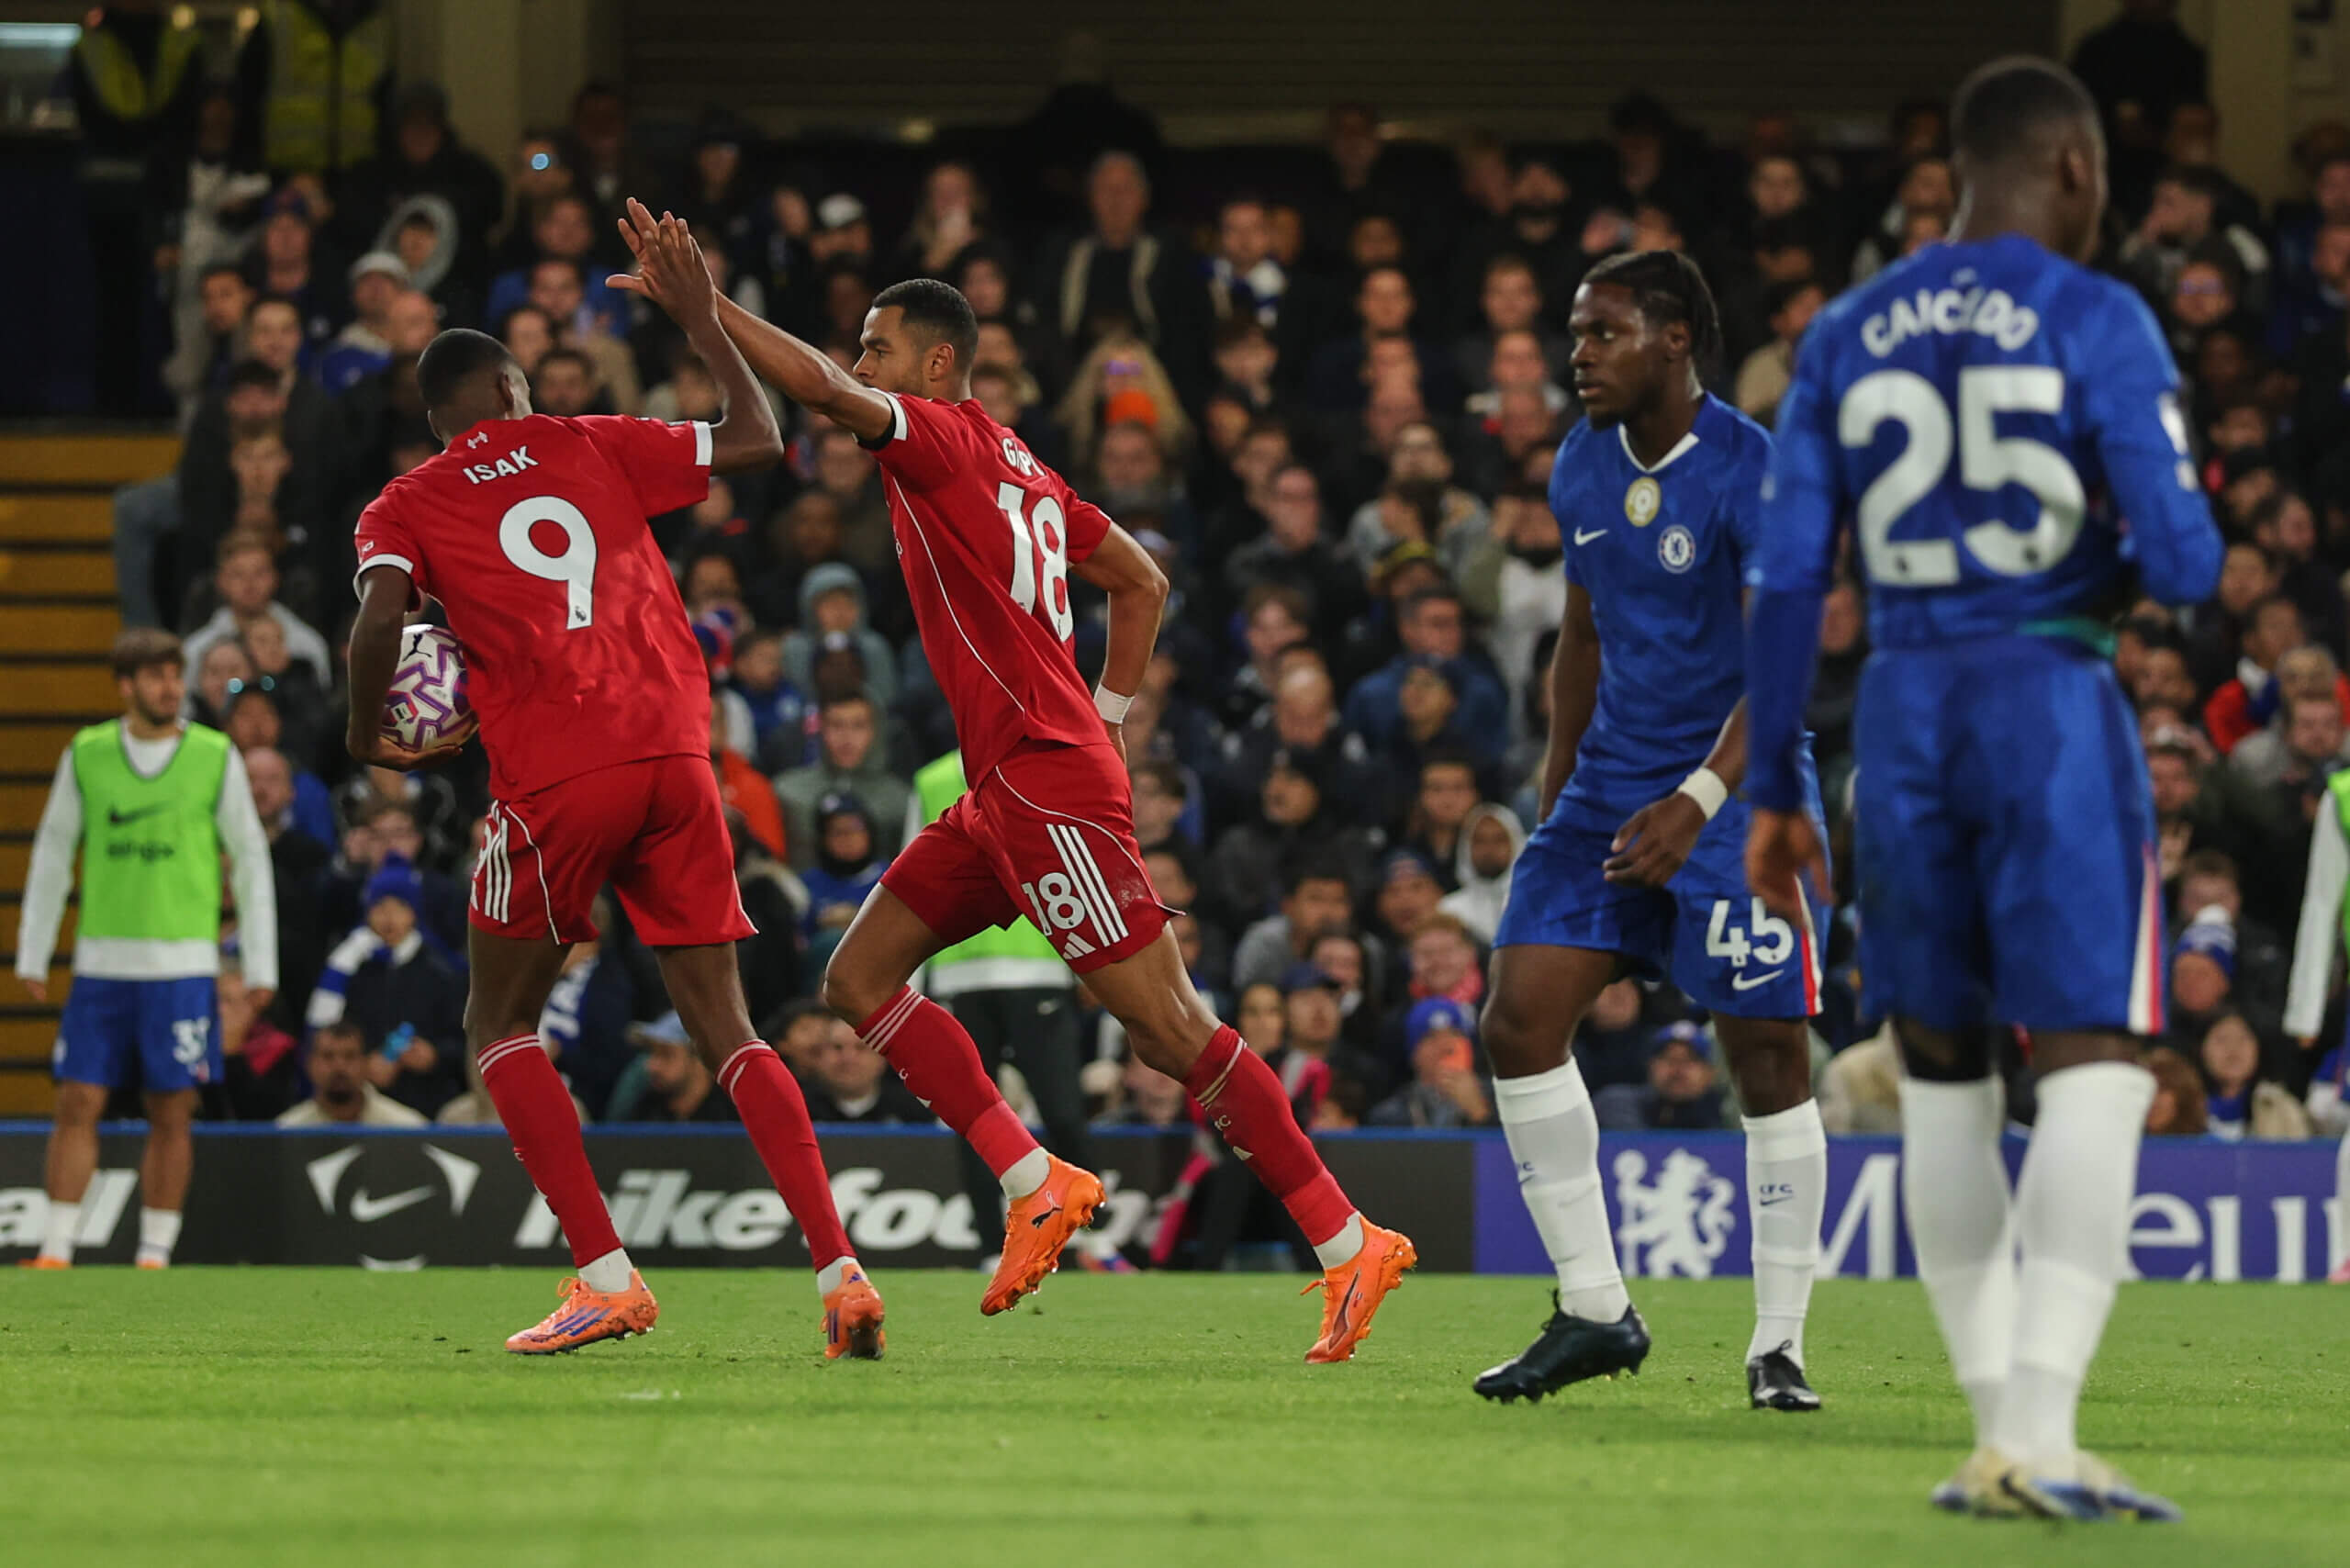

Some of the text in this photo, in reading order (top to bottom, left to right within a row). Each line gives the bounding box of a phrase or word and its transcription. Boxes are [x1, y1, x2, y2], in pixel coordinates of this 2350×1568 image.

[463, 445, 539, 485] ISAK
[1838, 364, 2087, 588] 25
[498, 496, 597, 631] 9
[997, 481, 1074, 643] 18
[1021, 871, 1085, 936] 18
[1705, 896, 1795, 968] 45
